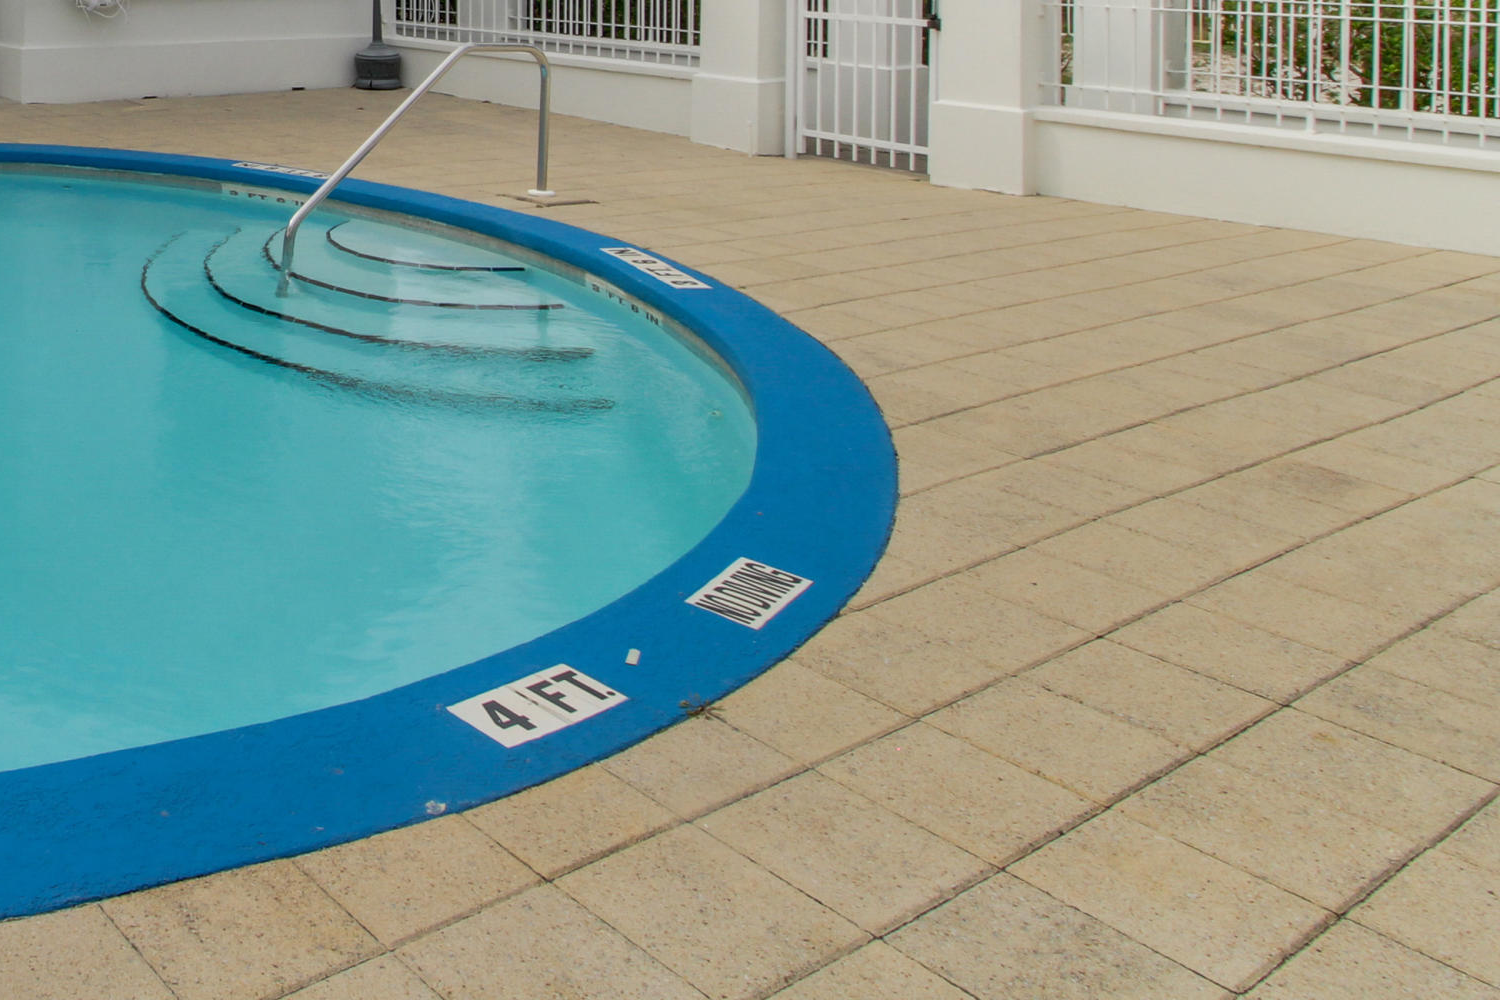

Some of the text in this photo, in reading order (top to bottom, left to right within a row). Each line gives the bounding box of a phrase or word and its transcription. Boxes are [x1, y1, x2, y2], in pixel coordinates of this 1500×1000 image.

[695, 562, 803, 625] NO DIVING
[482, 670, 617, 731] 4 FT.
